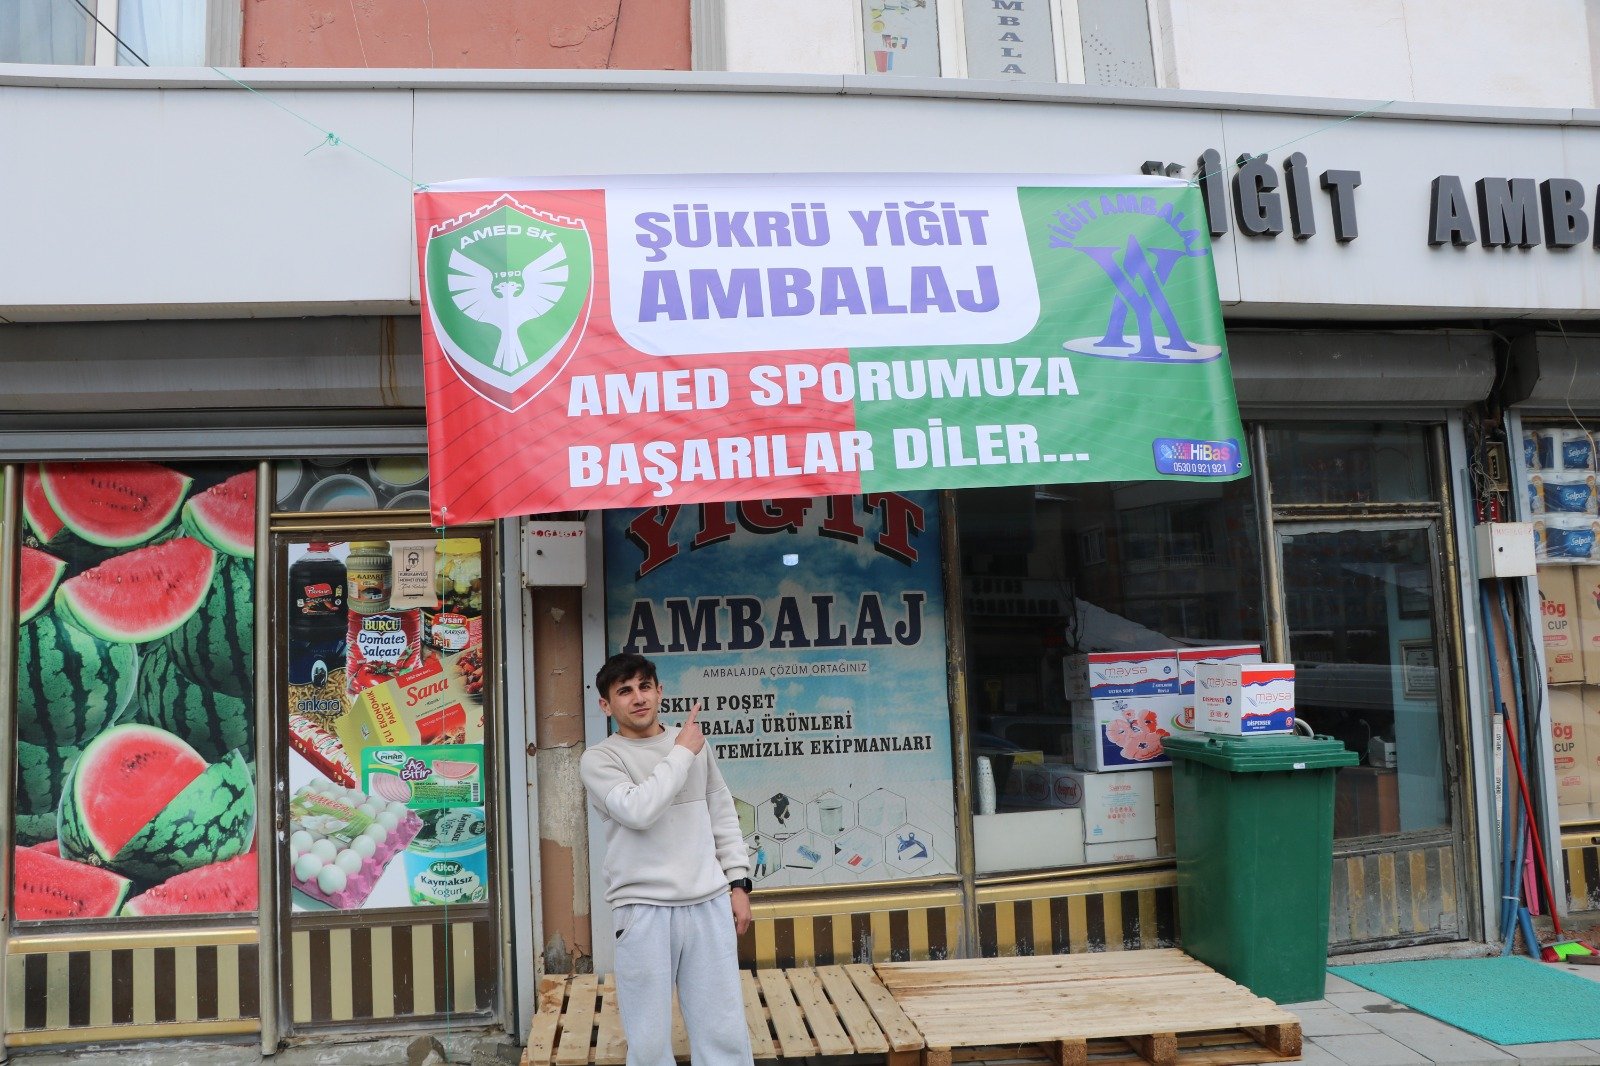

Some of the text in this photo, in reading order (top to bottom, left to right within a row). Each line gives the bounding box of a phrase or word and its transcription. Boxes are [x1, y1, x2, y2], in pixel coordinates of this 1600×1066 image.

[1141, 147, 1600, 249] İĞİT AMB
[634, 201, 990, 262] ŞÜKRÜ YİĞİT
[1048, 199, 1097, 248] YİĞİT
[460, 224, 558, 250] AMED SK
[494, 270, 522, 279] 1990
[637, 265, 1001, 323] AMBALAJ
[567, 357, 1080, 418] AMED SPORUMUZA
[568, 418, 1091, 499] BAŞARILAR DİLER...
[1190, 443, 1231, 461] HiBas
[1173, 462, 1191, 473] 0530
[1197, 463, 1211, 474] 921
[1212, 463, 1227, 473] 921
[1565, 490, 1587, 501] Selpak
[1571, 536, 1592, 546] Selpak
[365, 620, 399, 631] BURCU
[622, 593, 925, 654] AMBALAJ
[1548, 621, 1568, 630] CUP
[359, 633, 406, 645] Domates
[363, 646, 401, 659] Salçası
[702, 661, 868, 678] AMBALAJDA ÇÖZÜM ORTAĞINIZ
[1105, 665, 1148, 677] maysa
[1206, 677, 1238, 688] maysa
[406, 678, 449, 707] Sana
[1255, 692, 1292, 702] maysa
[298, 695, 341, 712] ankara
[658, 693, 775, 714] SKILI POŞET
[382, 702, 397, 725] PAKET
[676, 713, 852, 736] BALAJ ÜRÜNLERİ
[1553, 722, 1573, 740] ög
[716, 734, 932, 760] TEMİZLİK EKİPMANLARI
[1554, 742, 1575, 752] CUP
[420, 875, 473, 887] Kaymaksız
